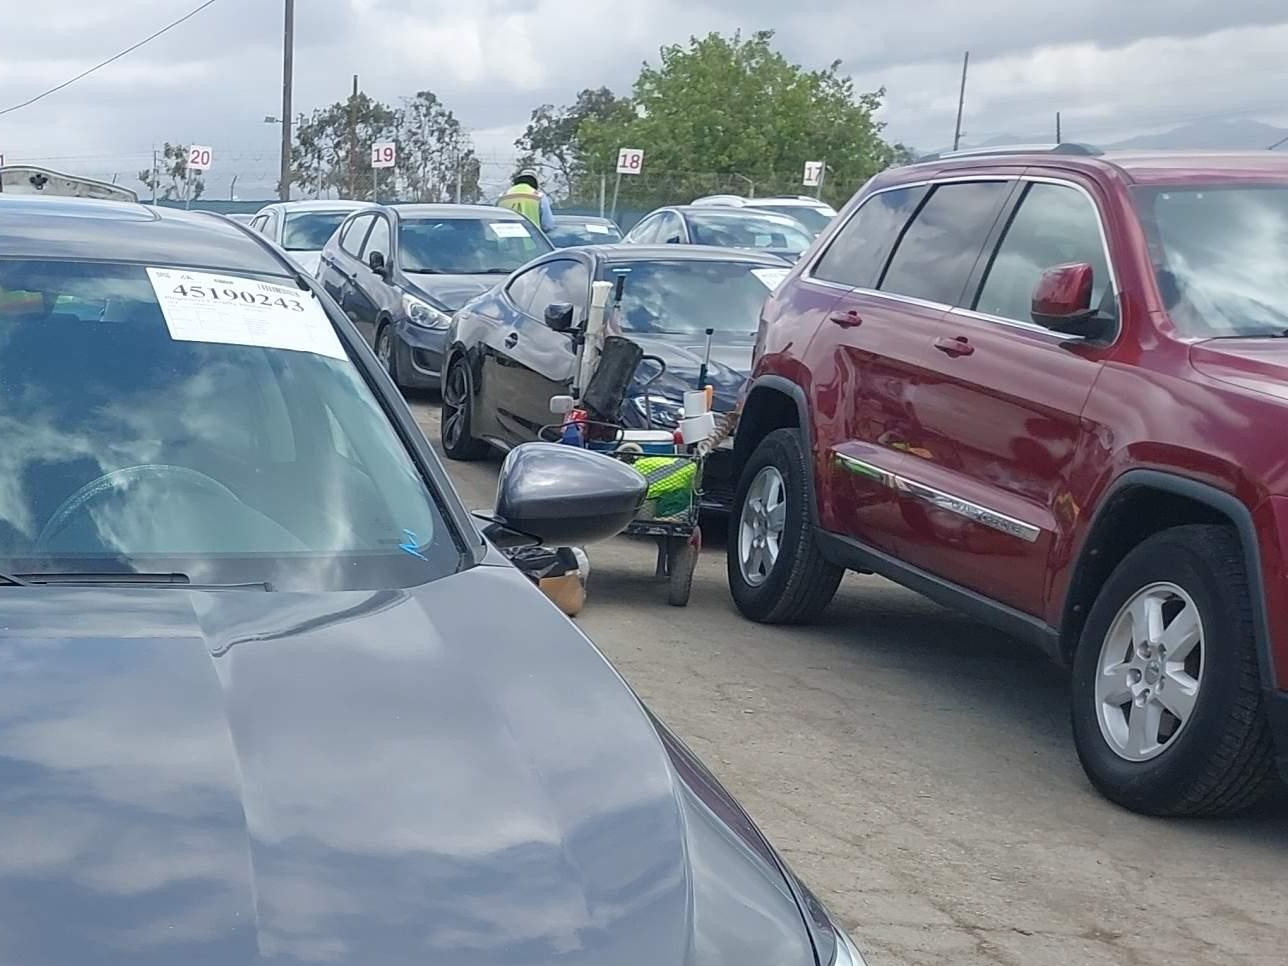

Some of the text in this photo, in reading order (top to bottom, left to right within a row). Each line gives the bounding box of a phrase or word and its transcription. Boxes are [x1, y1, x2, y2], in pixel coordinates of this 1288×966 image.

[190, 149, 210, 165] 20
[373, 147, 393, 162] 19
[619, 154, 640, 169] 18
[806, 166, 822, 181] 17
[172, 283, 305, 312] 45190243
